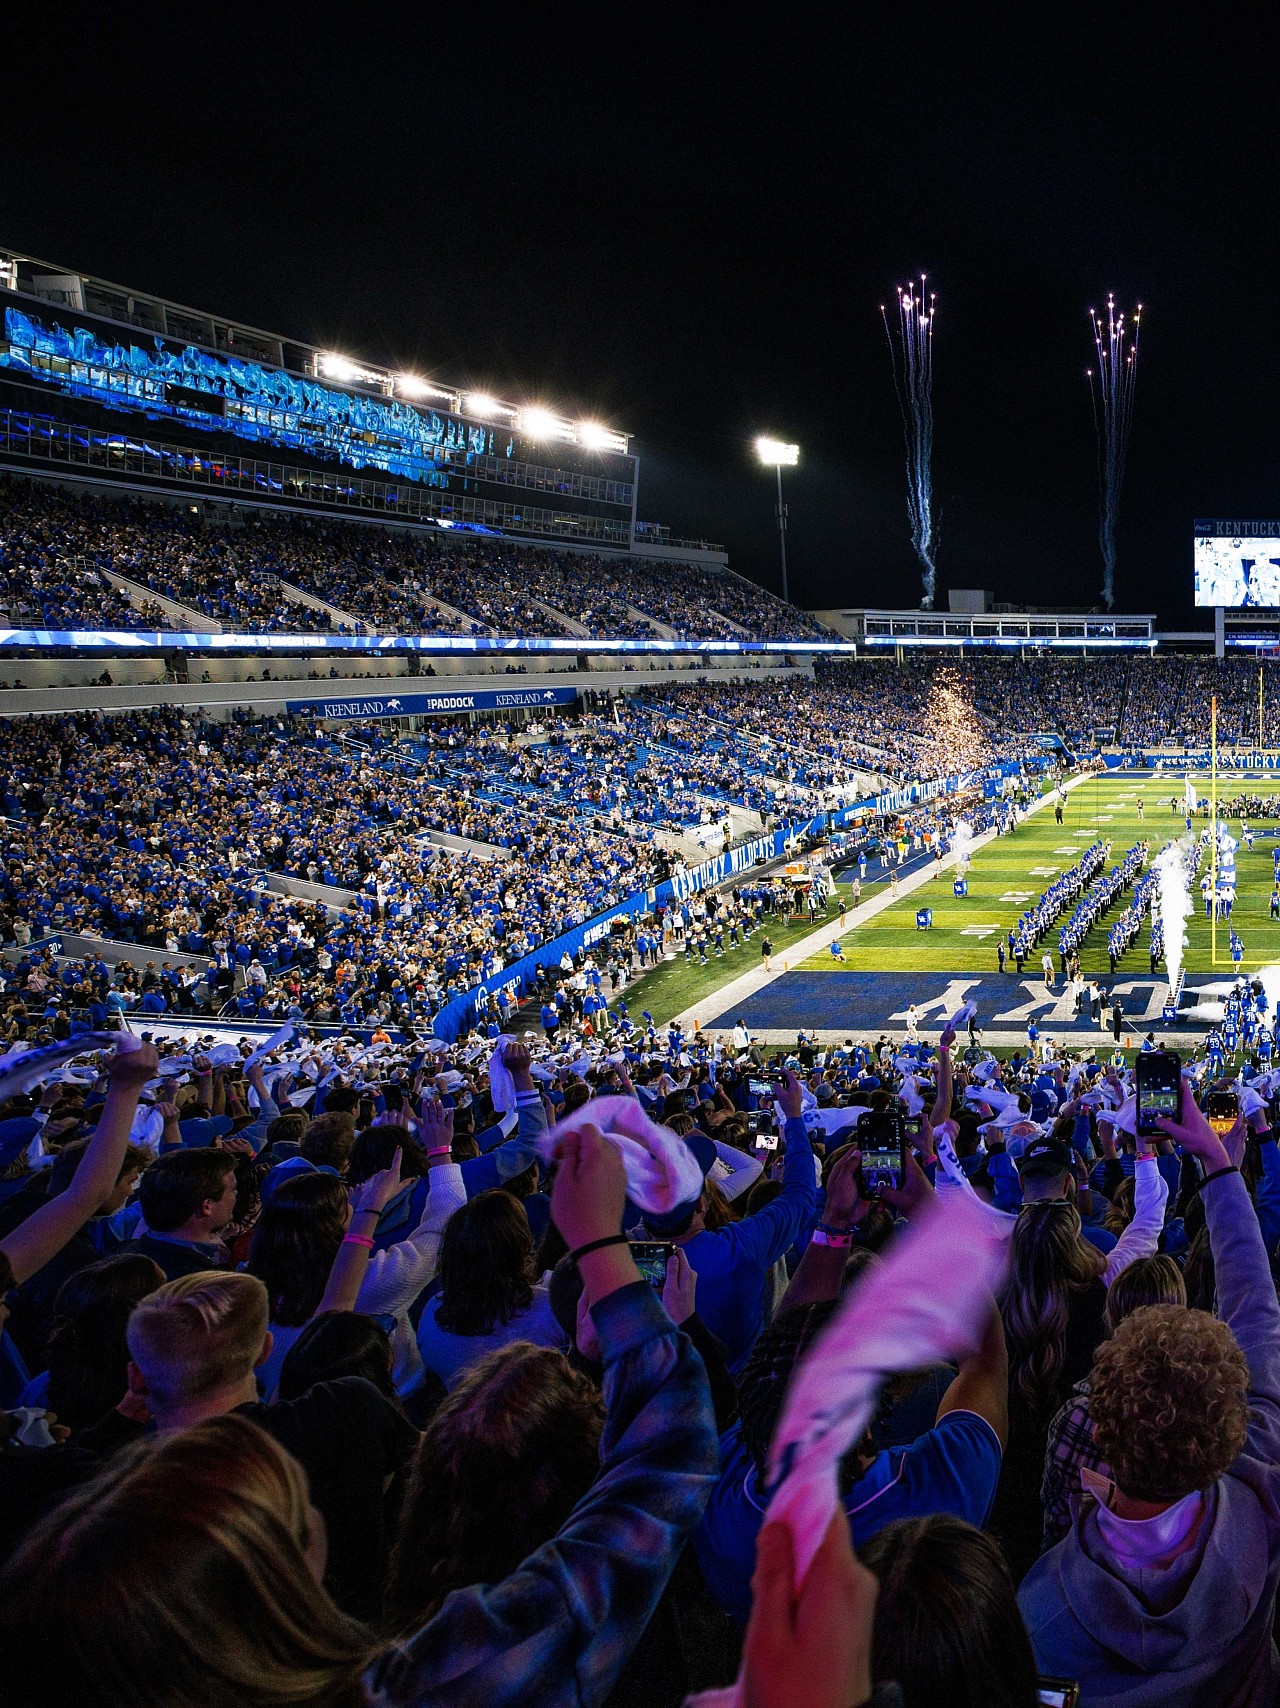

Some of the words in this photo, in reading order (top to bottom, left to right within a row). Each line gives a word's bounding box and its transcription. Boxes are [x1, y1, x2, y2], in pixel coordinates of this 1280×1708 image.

[324, 701, 383, 717] KEENELAND
[432, 697, 474, 709] PADDOCK
[496, 693, 540, 706] KEENELAND
[1216, 756, 1279, 768] KENTUCKY
[876, 786, 912, 813] KENTUCKY
[916, 778, 948, 801] WILDCATS
[671, 853, 726, 901] KENTUCKY
[731, 835, 775, 873] WILDCATS
[1209, 1040, 1220, 1049] 33
